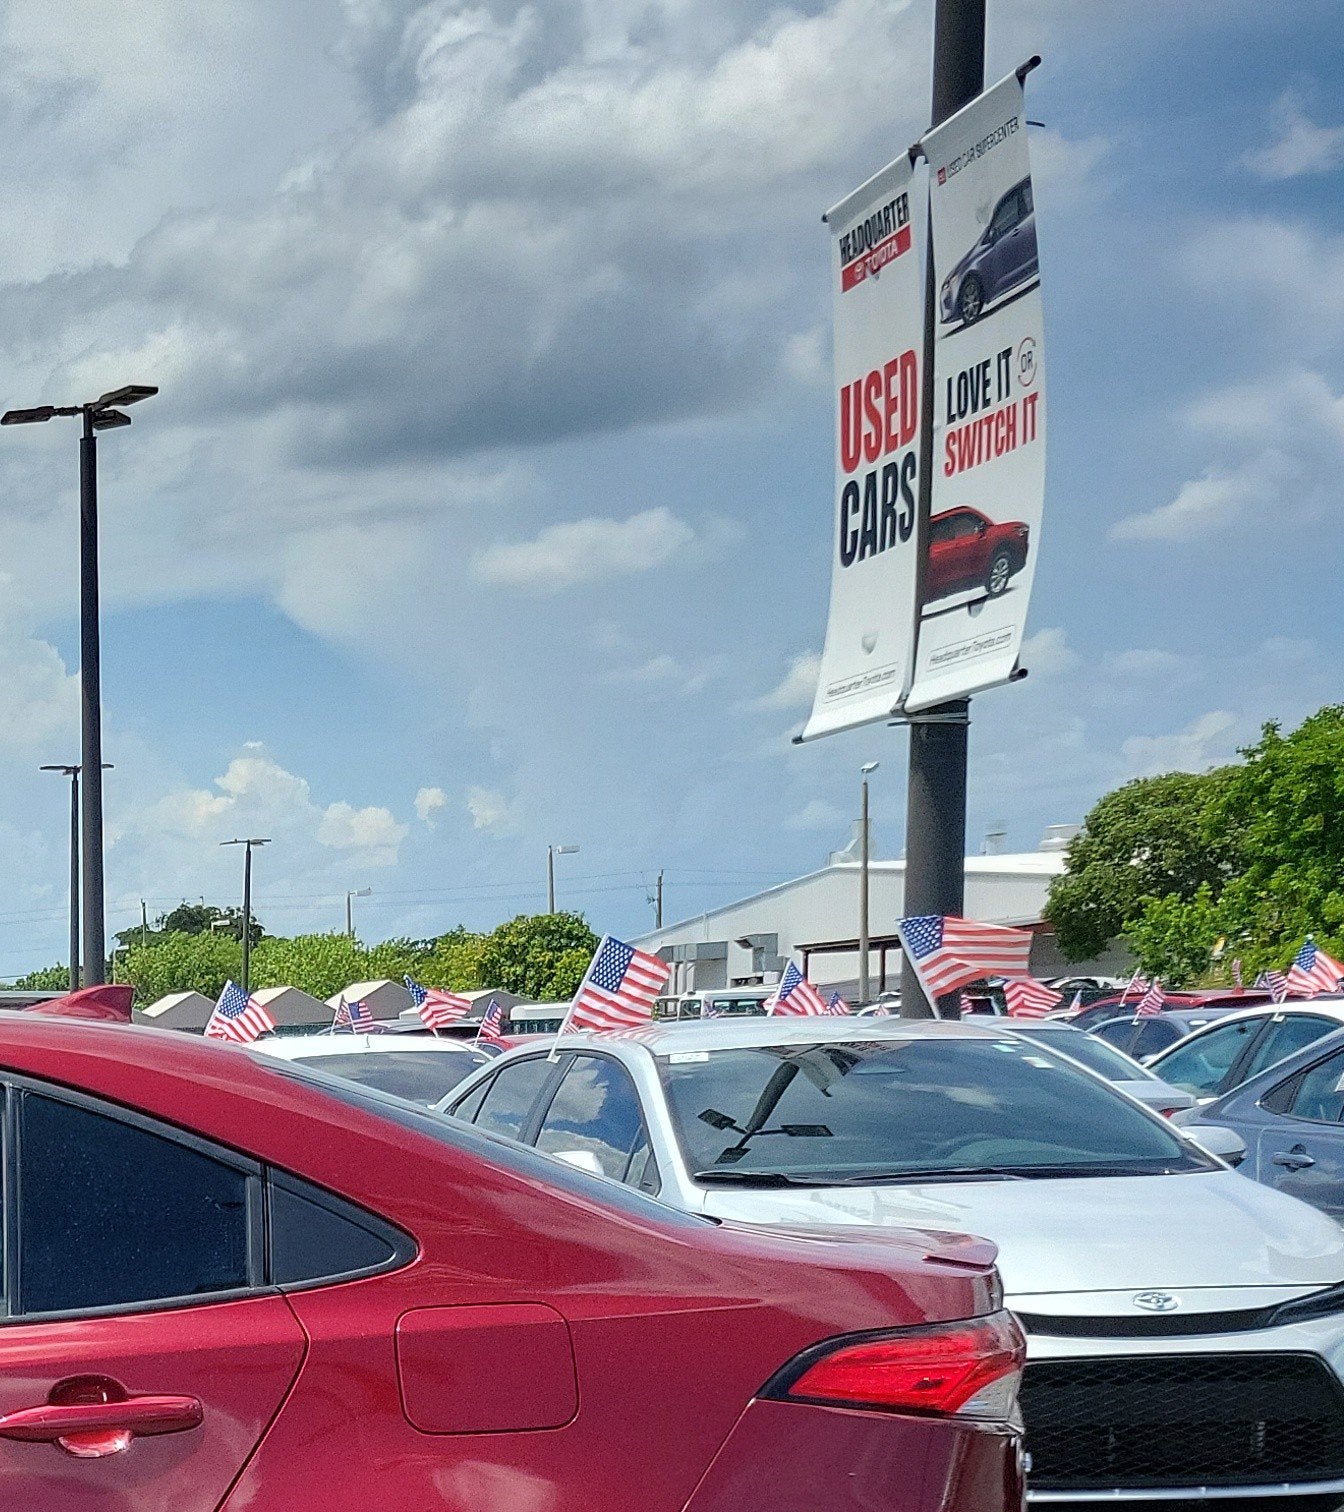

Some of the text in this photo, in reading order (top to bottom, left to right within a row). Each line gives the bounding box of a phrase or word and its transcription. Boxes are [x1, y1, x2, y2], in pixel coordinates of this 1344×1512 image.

[839, 191, 911, 267] HEADQUARTER
[946, 347, 1013, 424] LOVE IT
[1021, 351, 1033, 372] OR
[840, 349, 918, 474] USED
[944, 392, 1038, 477] SWITCH IT
[840, 451, 916, 567] CARS
